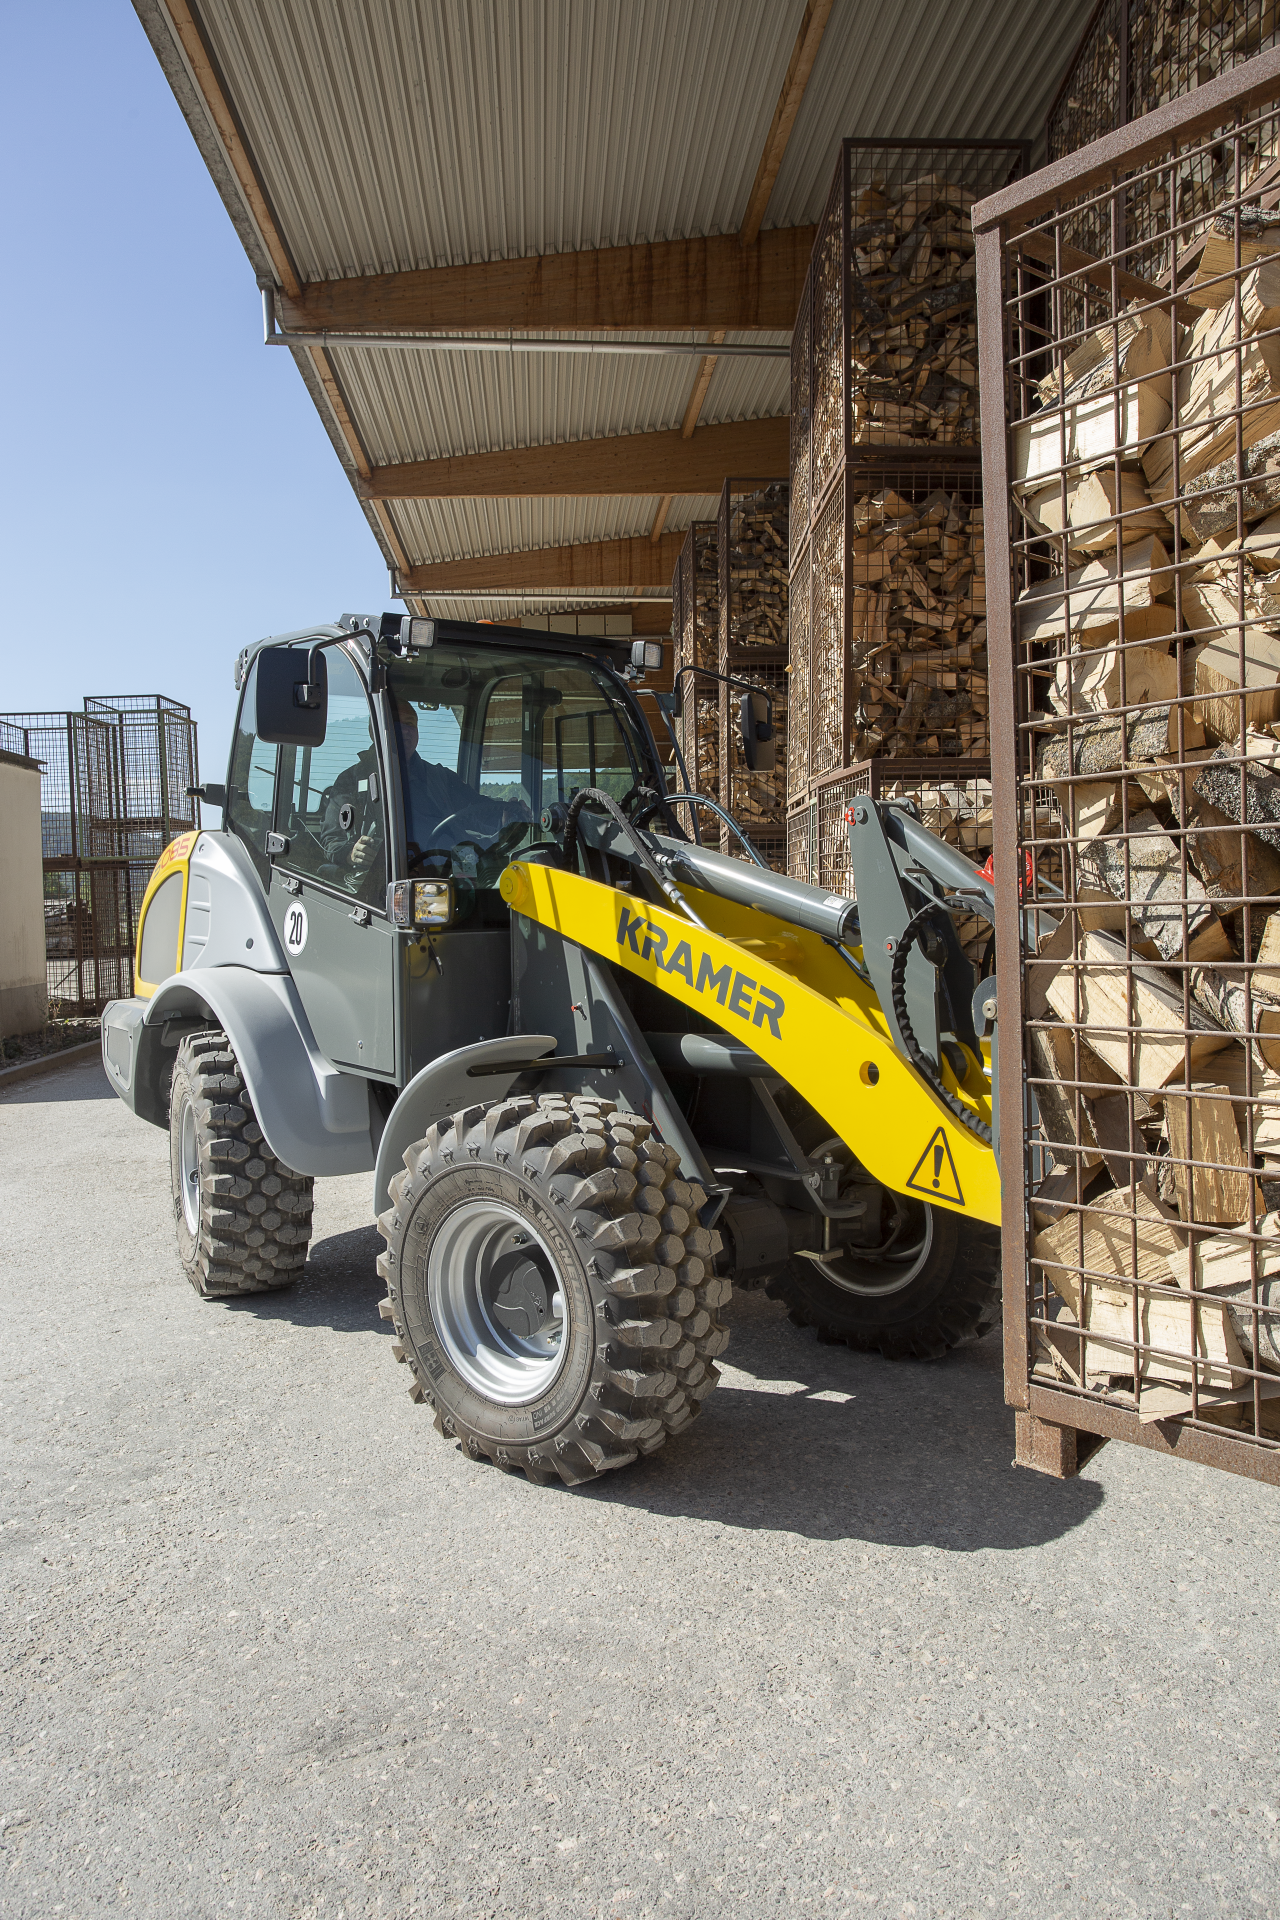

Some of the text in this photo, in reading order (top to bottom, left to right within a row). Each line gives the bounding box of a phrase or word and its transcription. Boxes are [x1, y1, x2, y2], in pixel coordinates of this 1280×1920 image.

[289, 911, 303, 945] 20
[616, 907, 785, 1041] KRAMER
[536, 1207, 588, 1324] MICHELIN
